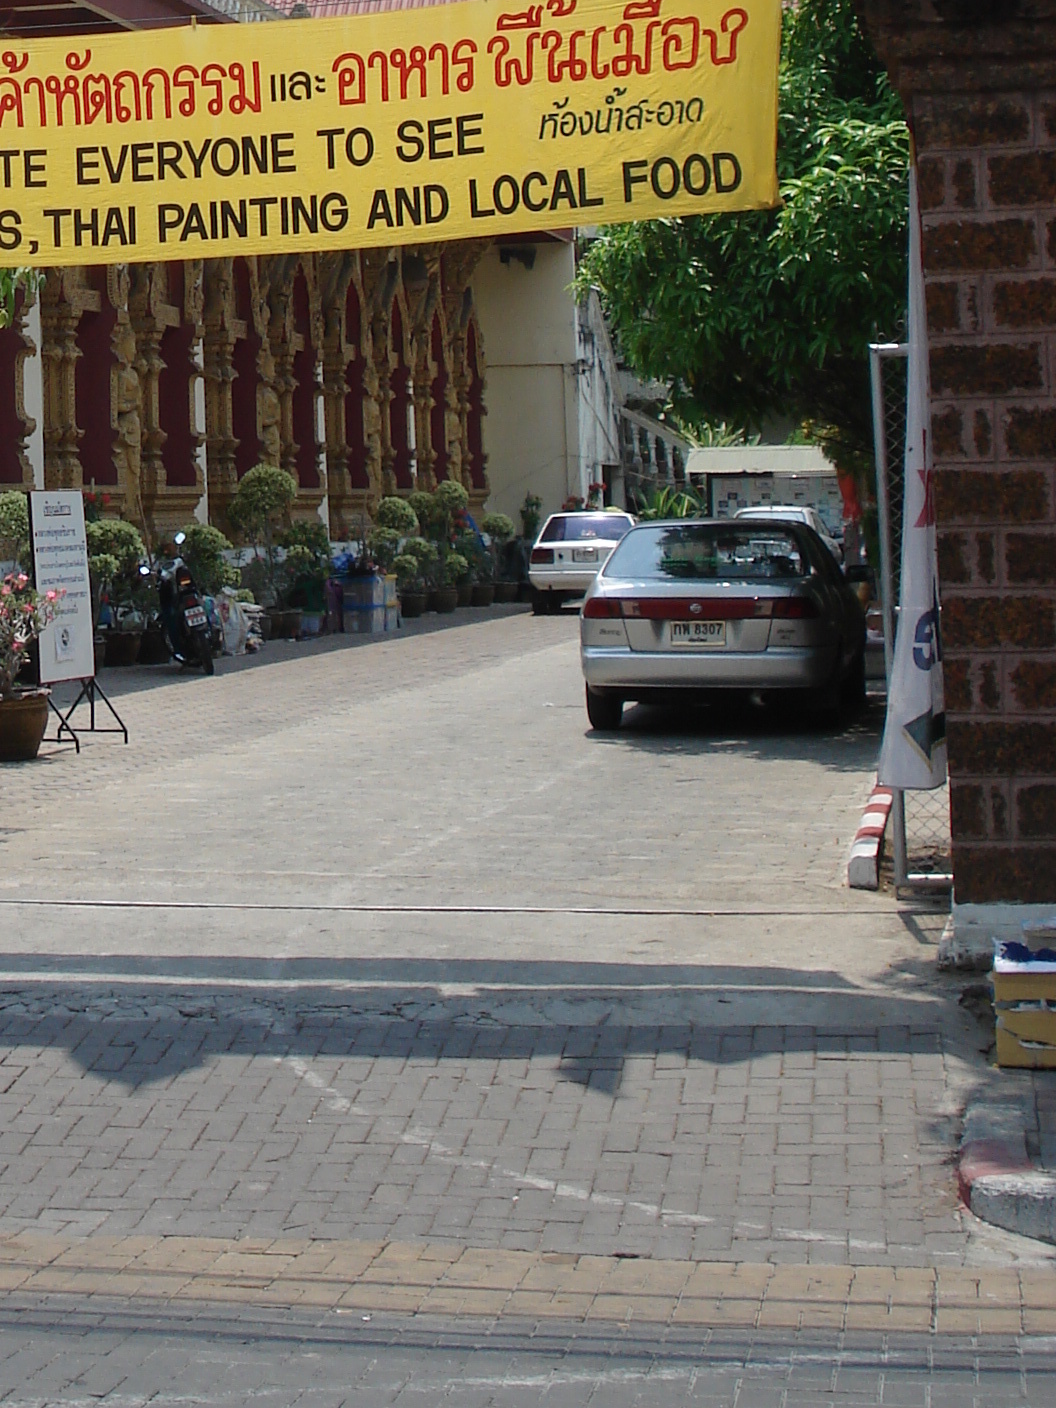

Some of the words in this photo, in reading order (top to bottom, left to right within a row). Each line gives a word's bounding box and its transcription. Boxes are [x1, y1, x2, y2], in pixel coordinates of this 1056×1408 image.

[271, 72, 325, 101] และ
[332, 39, 477, 105] อาหาร
[538, 88, 703, 139] ห้องน้ำสะอาด
[77, 133, 296, 185] EVERYONE
[317, 128, 373, 169] TO
[397, 114, 484, 162] SEE
[158, 193, 348, 242] PAINTING
[367, 185, 449, 229] AND
[469, 168, 603, 218] LOCAL
[623, 153, 741, 203] FOOD
[694, 623, 723, 635] 8307
